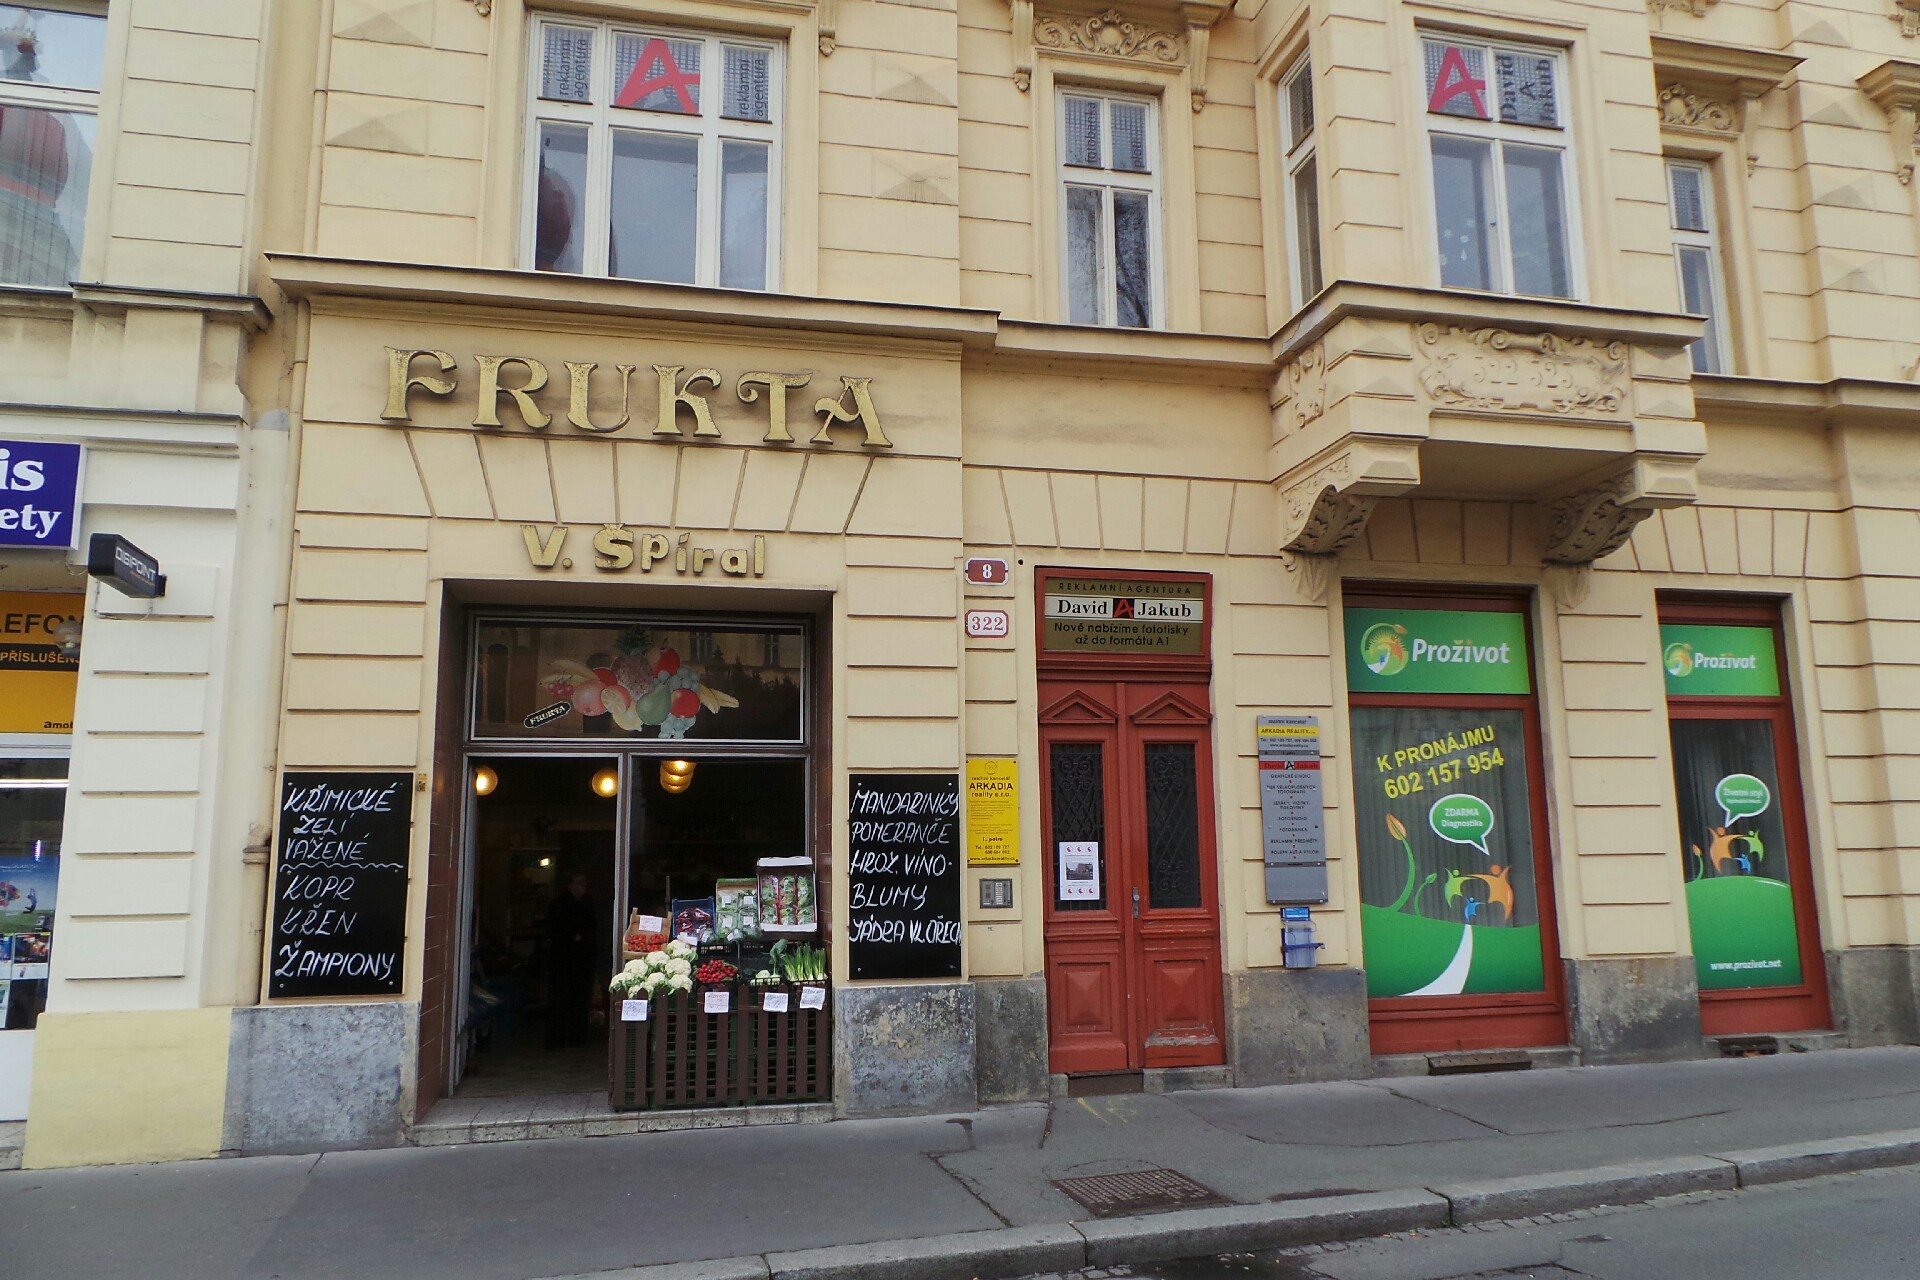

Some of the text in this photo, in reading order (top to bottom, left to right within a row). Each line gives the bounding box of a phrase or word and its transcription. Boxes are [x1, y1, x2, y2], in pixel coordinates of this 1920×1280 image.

[557, 39, 571, 96] reklamní
[574, 39, 588, 98] agentura
[737, 58, 750, 115] reklamní
[754, 58, 768, 117] agentura
[1495, 55, 1517, 120] David
[1537, 59, 1555, 124] Jakub
[1084, 102, 1098, 163] fotobanka
[380, 346, 893, 448] FRUKTA
[520, 522, 766, 577] V. Špíral
[982, 563, 993, 579] 8
[1058, 582, 1191, 595] REKLAMNÍ AGENTURA
[1057, 599, 1108, 615] David
[1137, 602, 1192, 618] Jakub
[971, 616, 1004, 631] 322
[1087, 623, 1139, 634] nabízíme
[1142, 624, 1189, 636] fototisky
[1075, 635, 1089, 645] až
[1091, 635, 1106, 645] do
[1109, 635, 1153, 646] formátu
[1412, 638, 1510, 663] Proživot
[529, 705, 566, 725] FRUKTA
[1377, 725, 1495, 773] K PRONÁJMU
[969, 782, 1014, 790] ARKADIA
[1384, 747, 1504, 799] 602 157 954
[283, 782, 398, 813] KŘIMICKÉ
[850, 789, 959, 817] MANDARINKY
[1444, 807, 1480, 817] ZDARMA
[851, 818, 953, 844] POMERANČE
[1441, 819, 1484, 829] Diagnostika
[283, 875, 356, 901] KOPR
[850, 882, 928, 911] BLUMY
[280, 903, 357, 935] KŘEN
[275, 940, 396, 981] ŽAMPIONY
